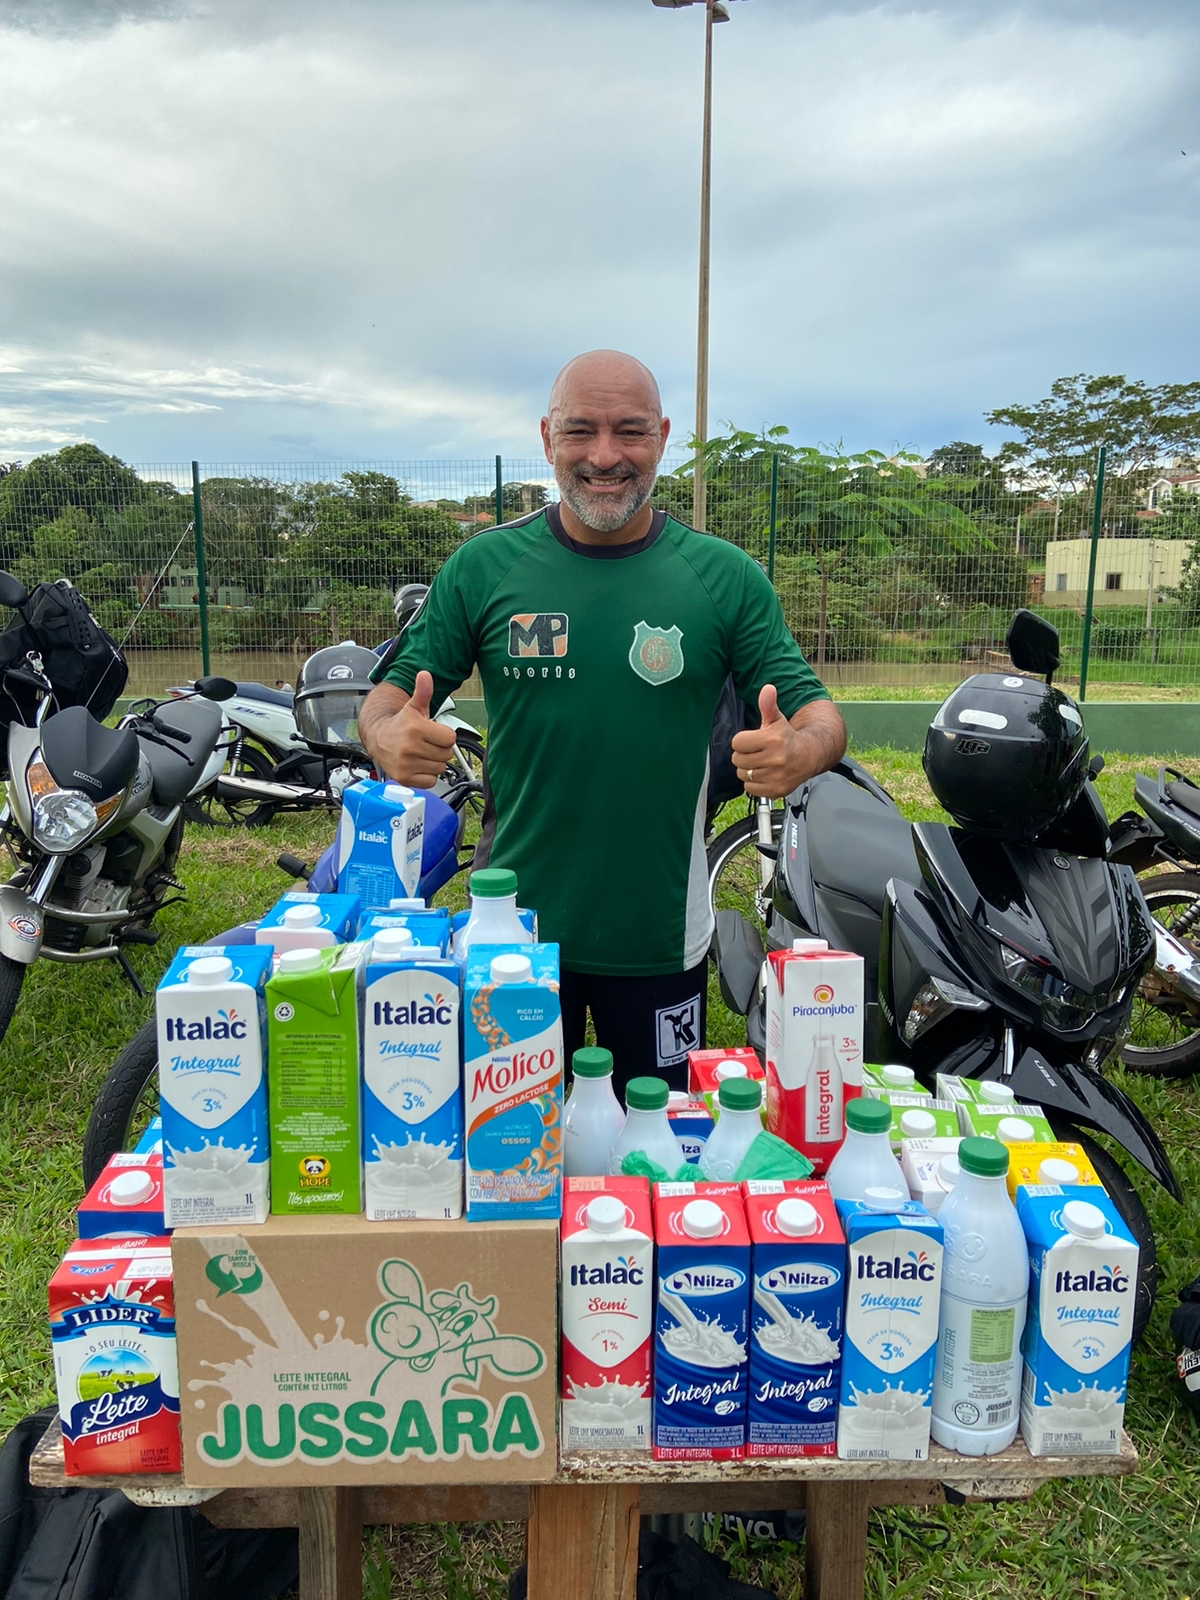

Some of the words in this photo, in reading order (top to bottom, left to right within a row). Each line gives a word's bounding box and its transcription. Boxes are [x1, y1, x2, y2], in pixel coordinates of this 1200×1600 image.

[508, 613, 569, 657] MP
[503, 665, 576, 680] sports
[73, 770, 102, 788] HONDA
[359, 830, 388, 844] Italac
[407, 821, 424, 844] Italac
[374, 1000, 452, 1026] Italac
[519, 1013, 544, 1021] CÁLCIO
[792, 1003, 855, 1017] Piracanjuba
[166, 1015, 247, 1042] Italac
[379, 1040, 442, 1058] Integral
[842, 1037, 857, 1048] 3%
[170, 1054, 241, 1074] Integral
[471, 1048, 555, 1104] Molico
[202, 1098, 222, 1113] 3%
[402, 1092, 426, 1111] 3%
[494, 1099, 515, 1114] ZERO
[515, 1082, 550, 1104] LACTOSE
[816, 1069, 834, 1136] integral
[681, 1144, 701, 1154] lza
[299, 1177, 332, 1188] HOPE
[171, 1198, 183, 1208] LEITE
[183, 1198, 193, 1208] UHT
[193, 1197, 215, 1208] INTEGRAL
[245, 1193, 254, 1204] 1L
[288, 1192, 303, 1205] Nós
[304, 1190, 344, 1205] apoiamos!
[375, 1209, 386, 1219] LEITE
[386, 1209, 397, 1219] UHT
[397, 1209, 417, 1219] INTEGRAL
[444, 1207, 452, 1218] 1L
[571, 1262, 643, 1286] Italac
[857, 1255, 936, 1281] Italac
[693, 1274, 735, 1288] Nilza
[788, 1272, 829, 1286] Nilza
[1055, 1270, 1128, 1293] Italac
[588, 1297, 628, 1311] Semi
[860, 1292, 923, 1311] Integral
[72, 1307, 151, 1327] LIDER
[1056, 1305, 1120, 1323] Integral
[98, 1339, 115, 1350] SEU
[118, 1339, 143, 1351] LEITE
[867, 1333, 879, 1346] TEOR
[890, 1329, 913, 1346] GORDURA
[602, 1339, 618, 1352] 1%
[879, 1342, 905, 1360] 3%
[1082, 1346, 1100, 1359] 3%
[273, 1373, 302, 1383] LEITE
[303, 1372, 352, 1382] INTEGRAL
[755, 1368, 833, 1402] Integral
[942, 1368, 954, 1389] LEITE
[278, 1382, 310, 1391] CONTÉM
[311, 1383, 320, 1391] 12
[321, 1382, 348, 1391] LITROS
[662, 1371, 740, 1406] Integral
[84, 1391, 149, 1429] Leite
[986, 1399, 1012, 1411] JUSSARA
[96, 1421, 140, 1445] integral
[202, 1395, 541, 1461] JUSSARA
[570, 1426, 580, 1436] LEITE
[580, 1426, 590, 1437] UHT
[590, 1427, 625, 1437] SEMIDESNATADO
[637, 1425, 645, 1435] 1L
[1109, 1430, 1116, 1439] 1L
[1042, 1432, 1054, 1441] LEITE
[1063, 1432, 1083, 1441] INTEGRAL
[657, 1447, 672, 1458] LEITE
[672, 1447, 685, 1458] UHT
[685, 1447, 713, 1458] INTEGRAL
[750, 1444, 764, 1454] LEITE
[764, 1444, 777, 1454] UHT
[778, 1444, 804, 1454] INTEGRAL
[847, 1449, 859, 1458] LEITE
[858, 1449, 868, 1458] UHT
[868, 1449, 890, 1458] INTEGRAL
[915, 1448, 922, 1459] 1L
